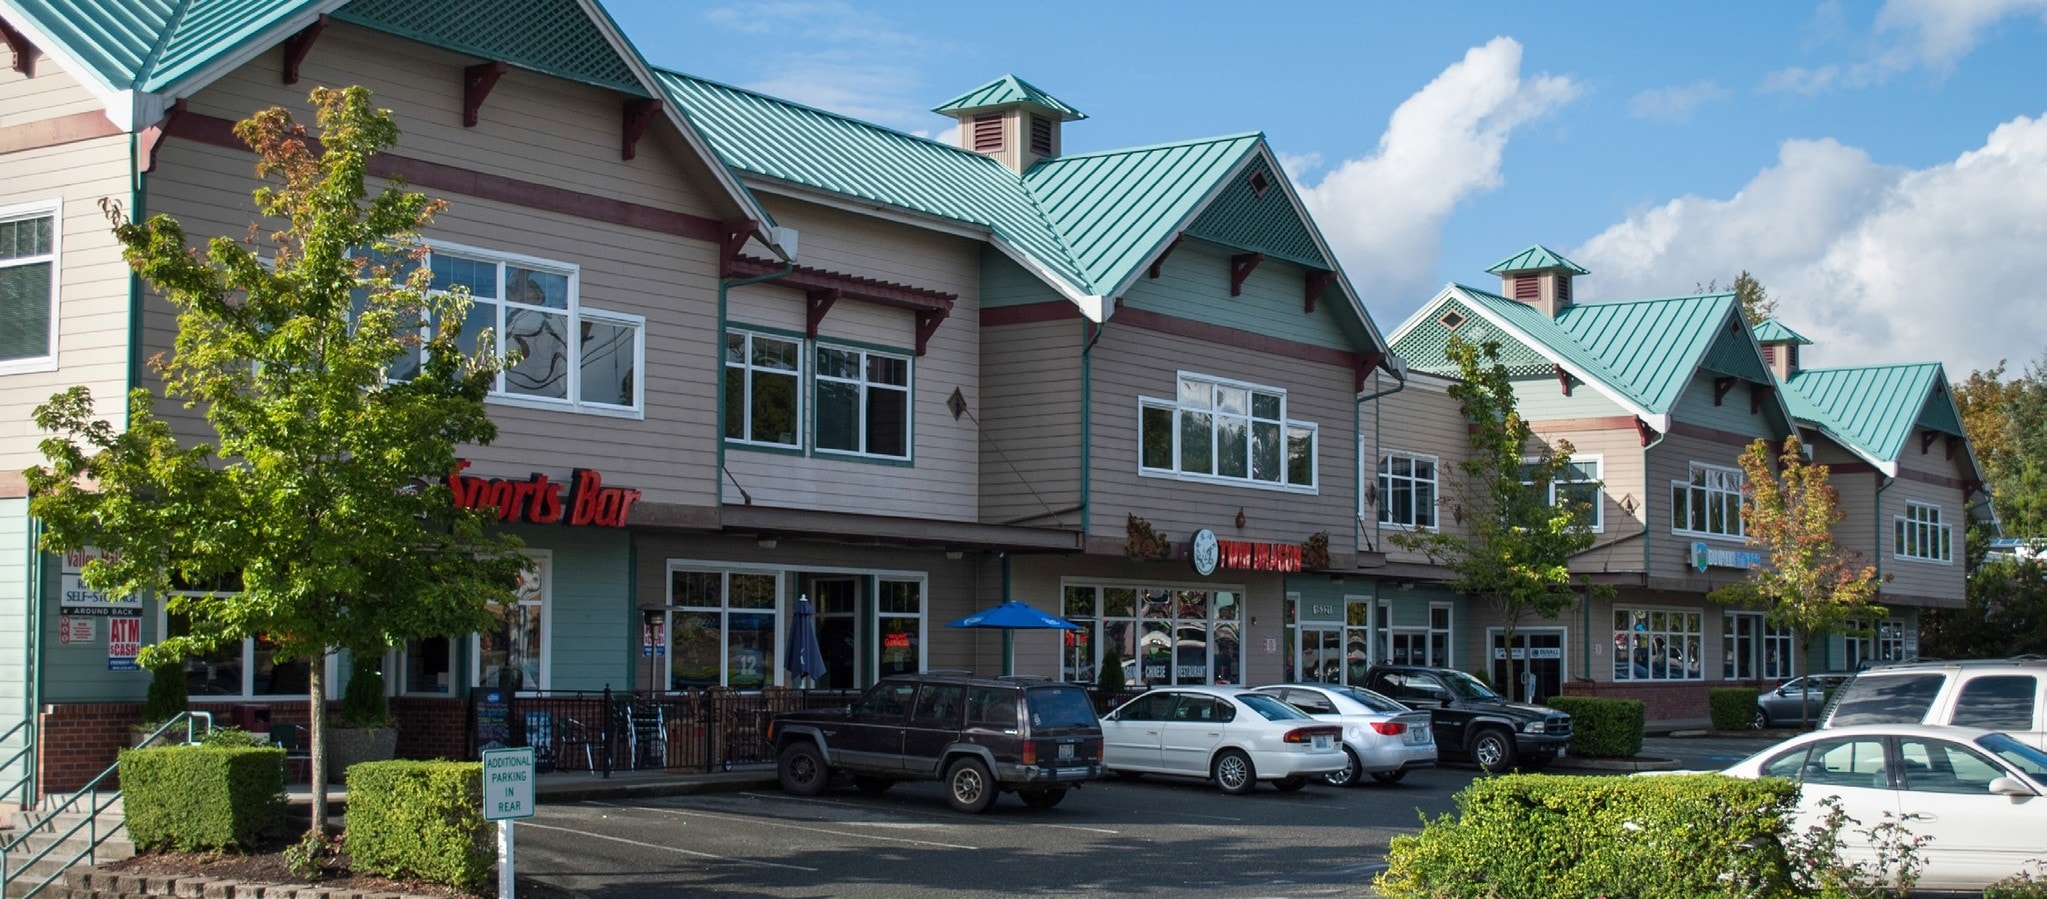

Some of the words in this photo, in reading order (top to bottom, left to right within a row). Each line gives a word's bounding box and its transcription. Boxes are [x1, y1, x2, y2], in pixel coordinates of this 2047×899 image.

[450, 458, 564, 524] Sports
[571, 468, 642, 528] Bar
[1220, 539, 1251, 569] TWIN
[1253, 542, 1302, 572] DRAGON
[1708, 549, 1735, 567] DUVALL
[66, 590, 138, 603] SELF-STOGE
[74, 608, 109, 616] AROUND
[112, 608, 134, 616] BACK
[110, 618, 140, 643] ATM
[740, 654, 757, 675] 12
[1145, 665, 1166, 678] CHINESE
[1177, 665, 1206, 678] RESTAURANT
[487, 756, 531, 768] ADDITIONAL
[492, 771, 527, 783] PARKING
[505, 787, 514, 797] IN
[498, 801, 521, 812] REAR
